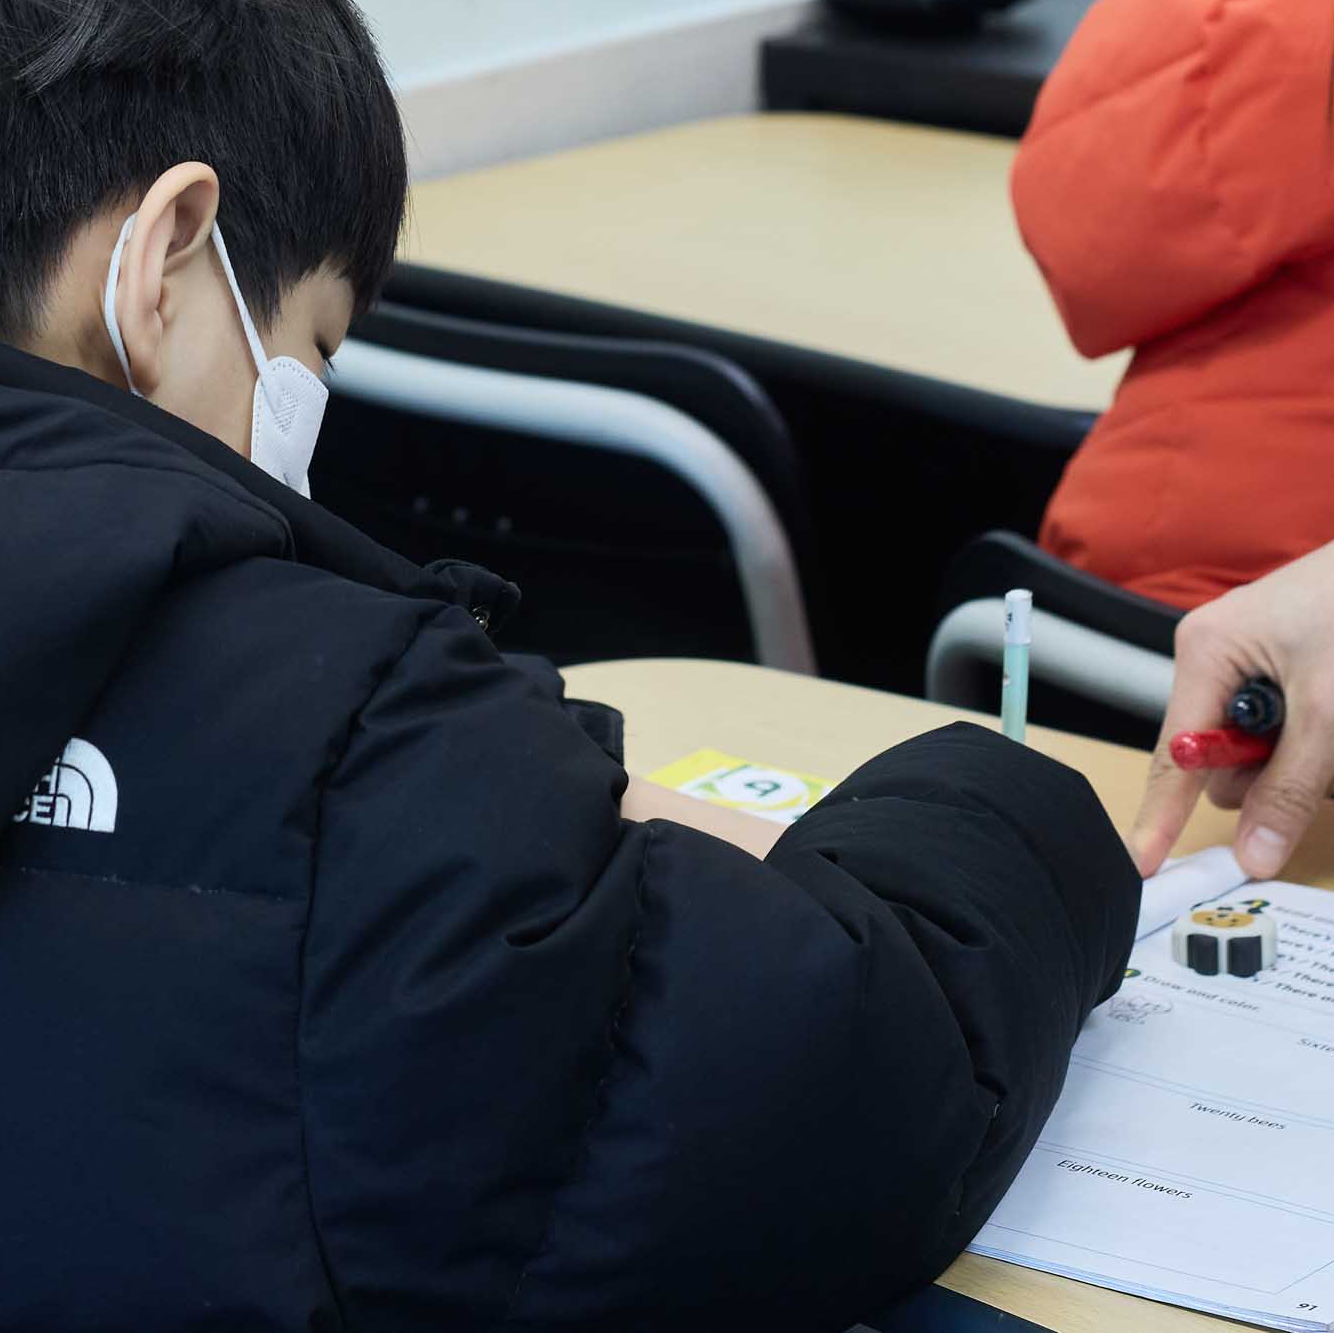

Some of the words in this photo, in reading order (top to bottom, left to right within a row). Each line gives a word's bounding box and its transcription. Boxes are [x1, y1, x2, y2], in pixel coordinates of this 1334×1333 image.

[1186, 987, 1218, 1001] and
[1275, 982, 1317, 998] There
[1189, 1101, 1246, 1122] Twenty
[1247, 1115, 1286, 1131] bees
[1056, 1158, 1130, 1183] Eighteen
[1131, 1177, 1194, 1200] flowers
